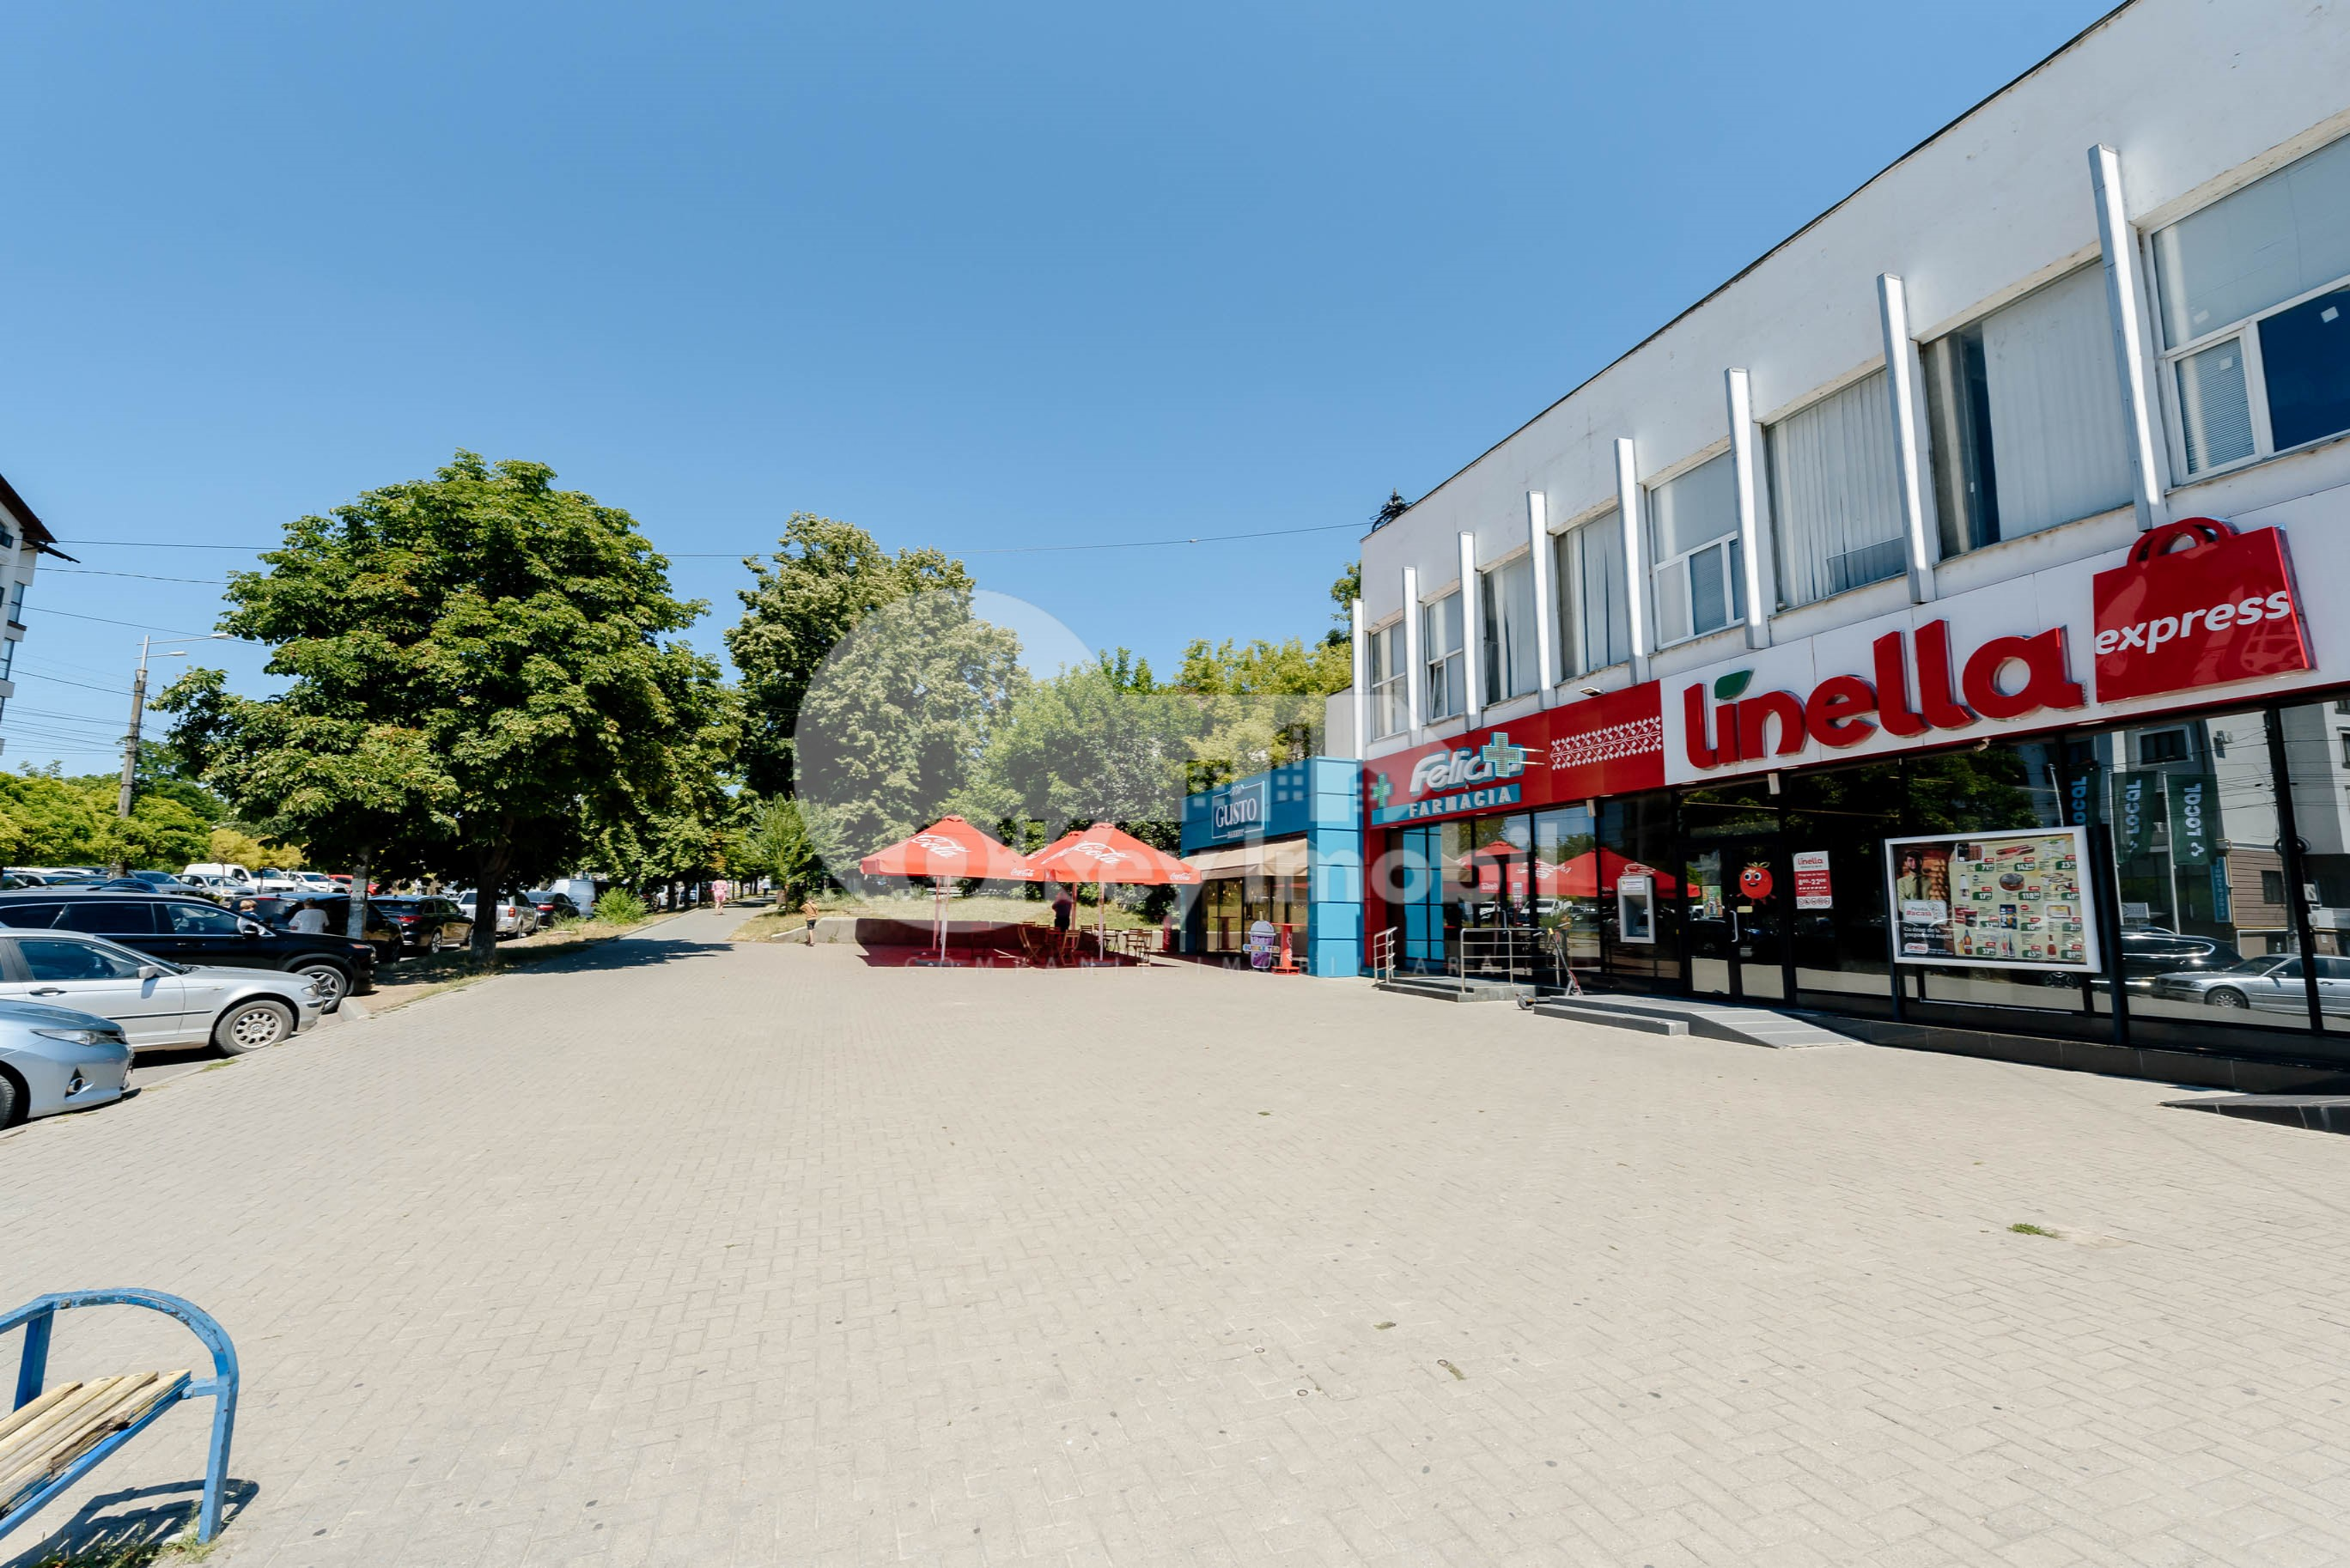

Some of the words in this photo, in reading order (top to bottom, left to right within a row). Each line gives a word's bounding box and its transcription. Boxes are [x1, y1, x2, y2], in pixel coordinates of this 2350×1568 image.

[2095, 590, 2290, 656] express
[1683, 619, 2085, 770] linella
[1409, 743, 1524, 793] Felici
[1215, 798, 1257, 828] GUSTO
[1409, 787, 1512, 817] FARMACIA
[2071, 776, 2087, 824] OCAL
[2184, 783, 2202, 837] LOCAL
